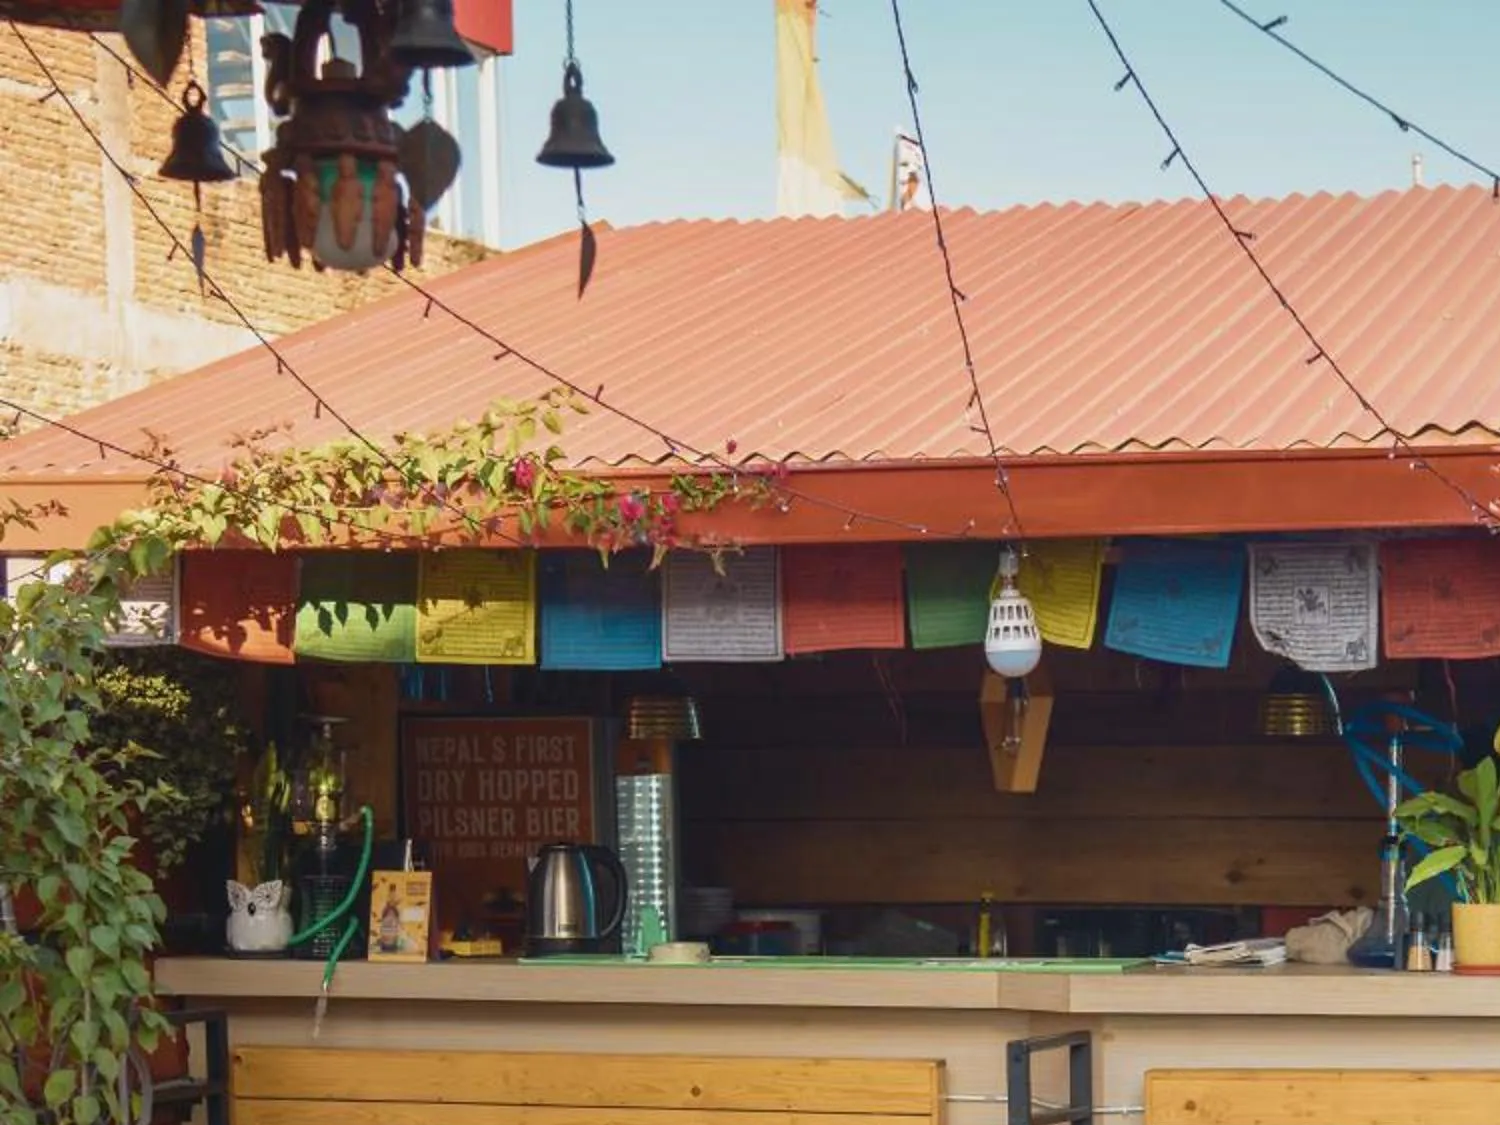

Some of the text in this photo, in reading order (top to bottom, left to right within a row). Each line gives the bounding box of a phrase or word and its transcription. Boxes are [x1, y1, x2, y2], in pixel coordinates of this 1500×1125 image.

[515, 735, 576, 764] FIRST
[418, 769, 580, 801] DRY HOPPED
[418, 806, 580, 837] PILSNER BIER
